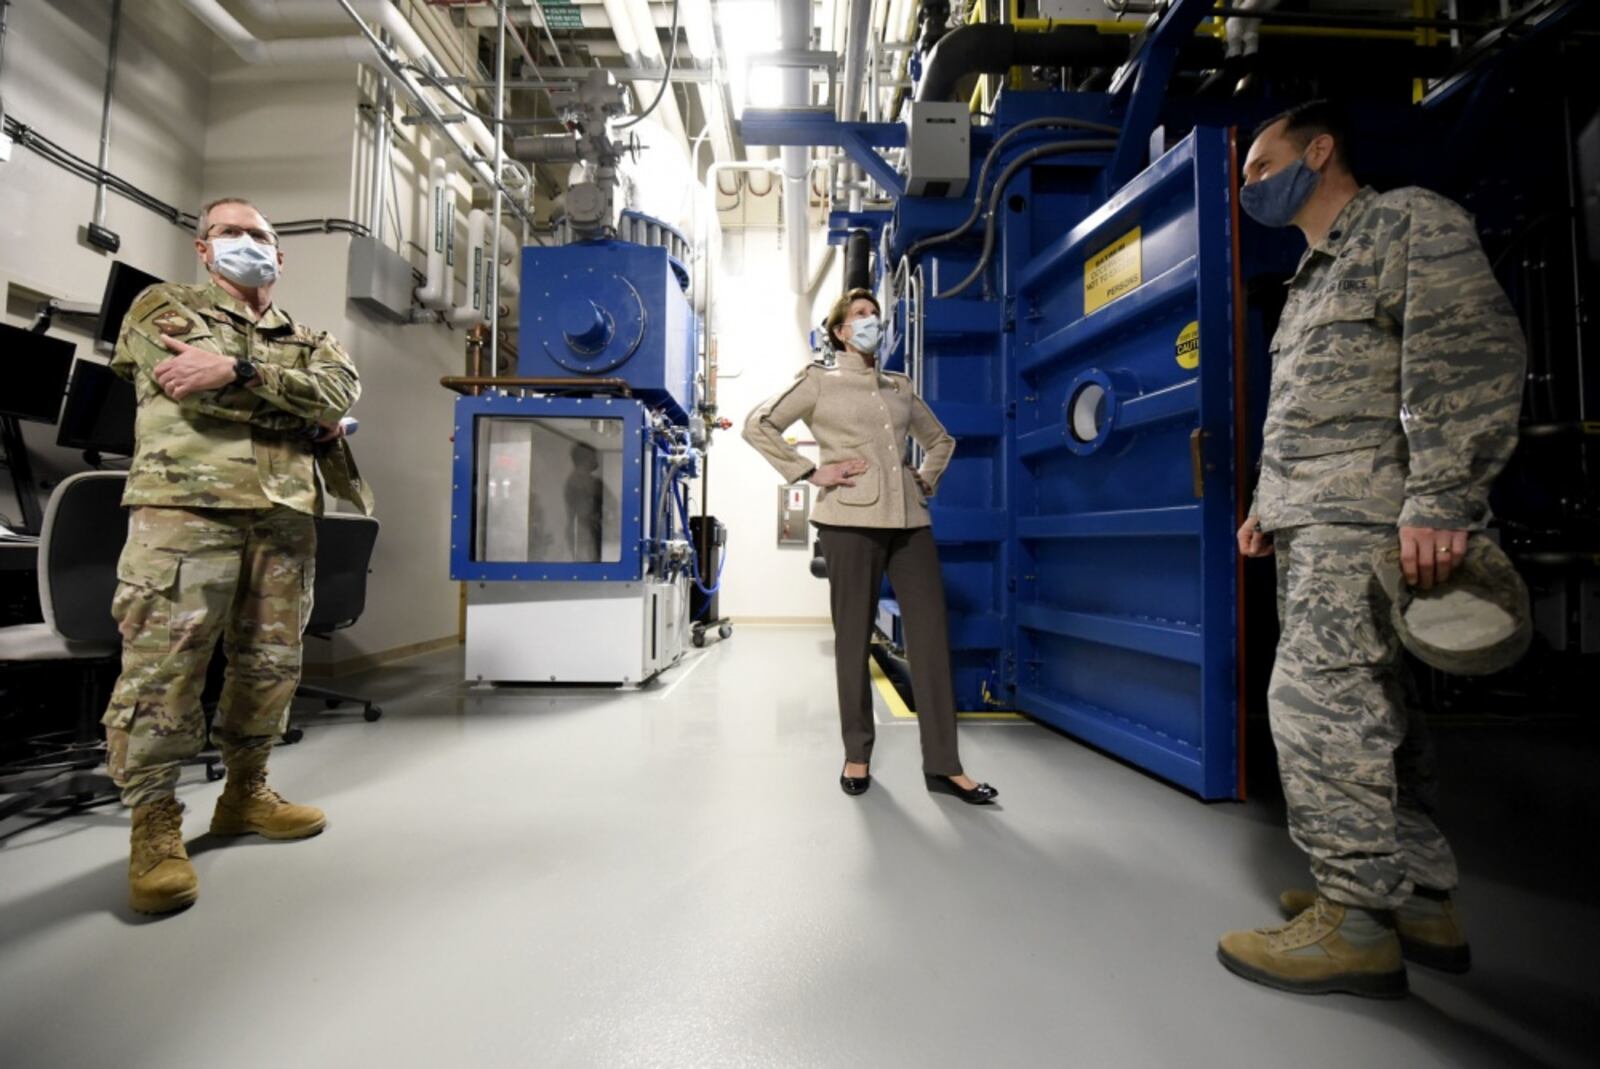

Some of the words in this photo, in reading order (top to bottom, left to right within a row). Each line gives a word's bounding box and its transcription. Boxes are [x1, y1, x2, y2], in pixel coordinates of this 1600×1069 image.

[1086, 278, 1099, 291] NOT
[1106, 274, 1139, 297] PERSONS
[1338, 279, 1368, 290] FORCE
